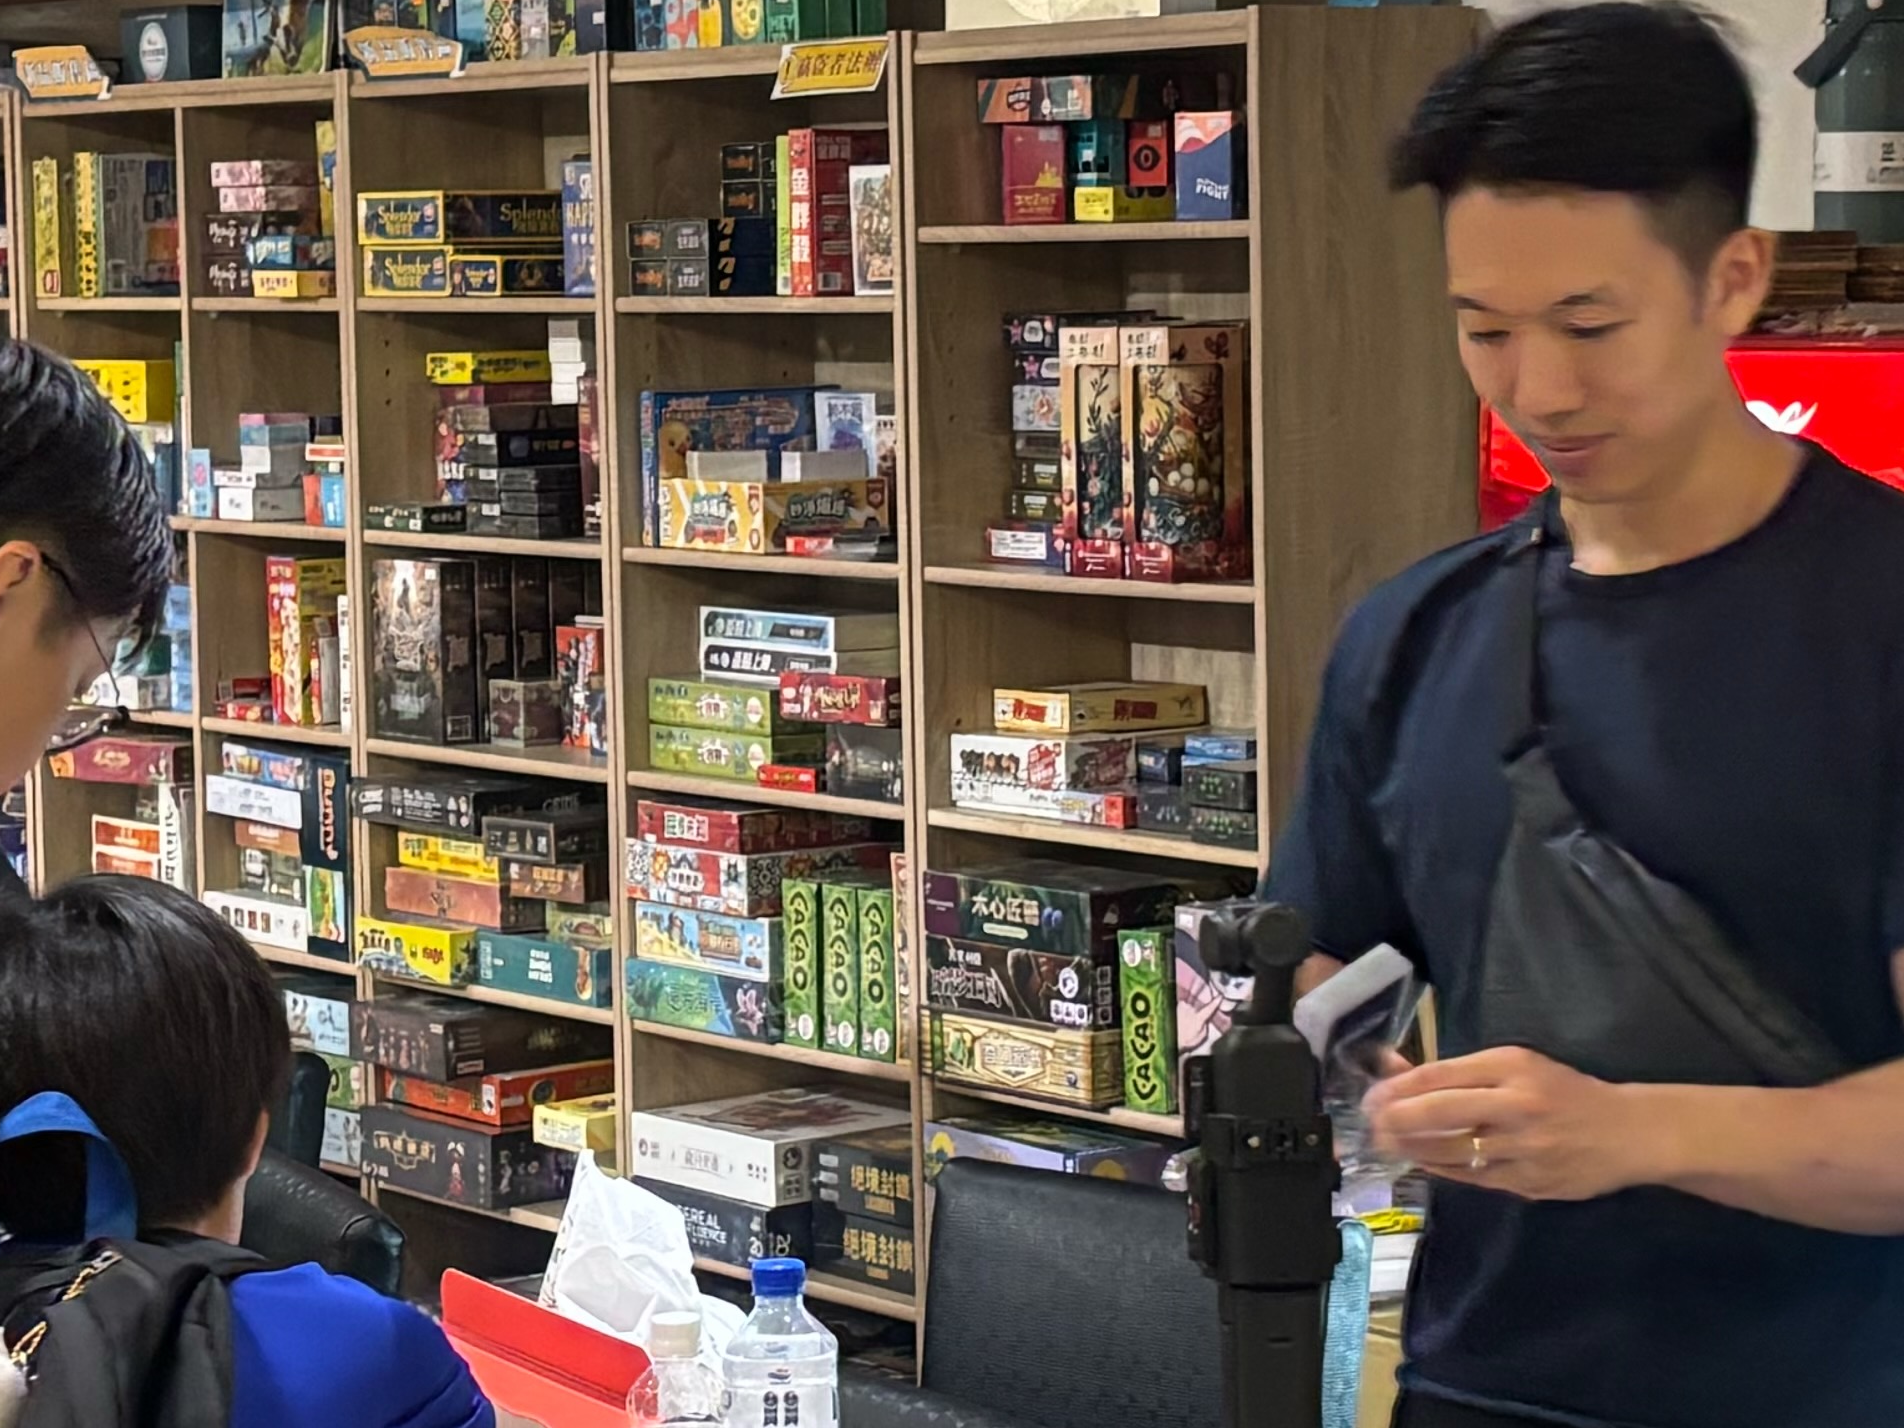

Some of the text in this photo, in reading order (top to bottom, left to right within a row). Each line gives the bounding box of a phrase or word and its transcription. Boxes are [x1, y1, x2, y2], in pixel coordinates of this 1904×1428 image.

[789, 890, 810, 992] CACAO
[829, 896, 850, 999] CACAO
[864, 902, 885, 1005] CACAO
[1129, 990, 1158, 1102] CACAO
